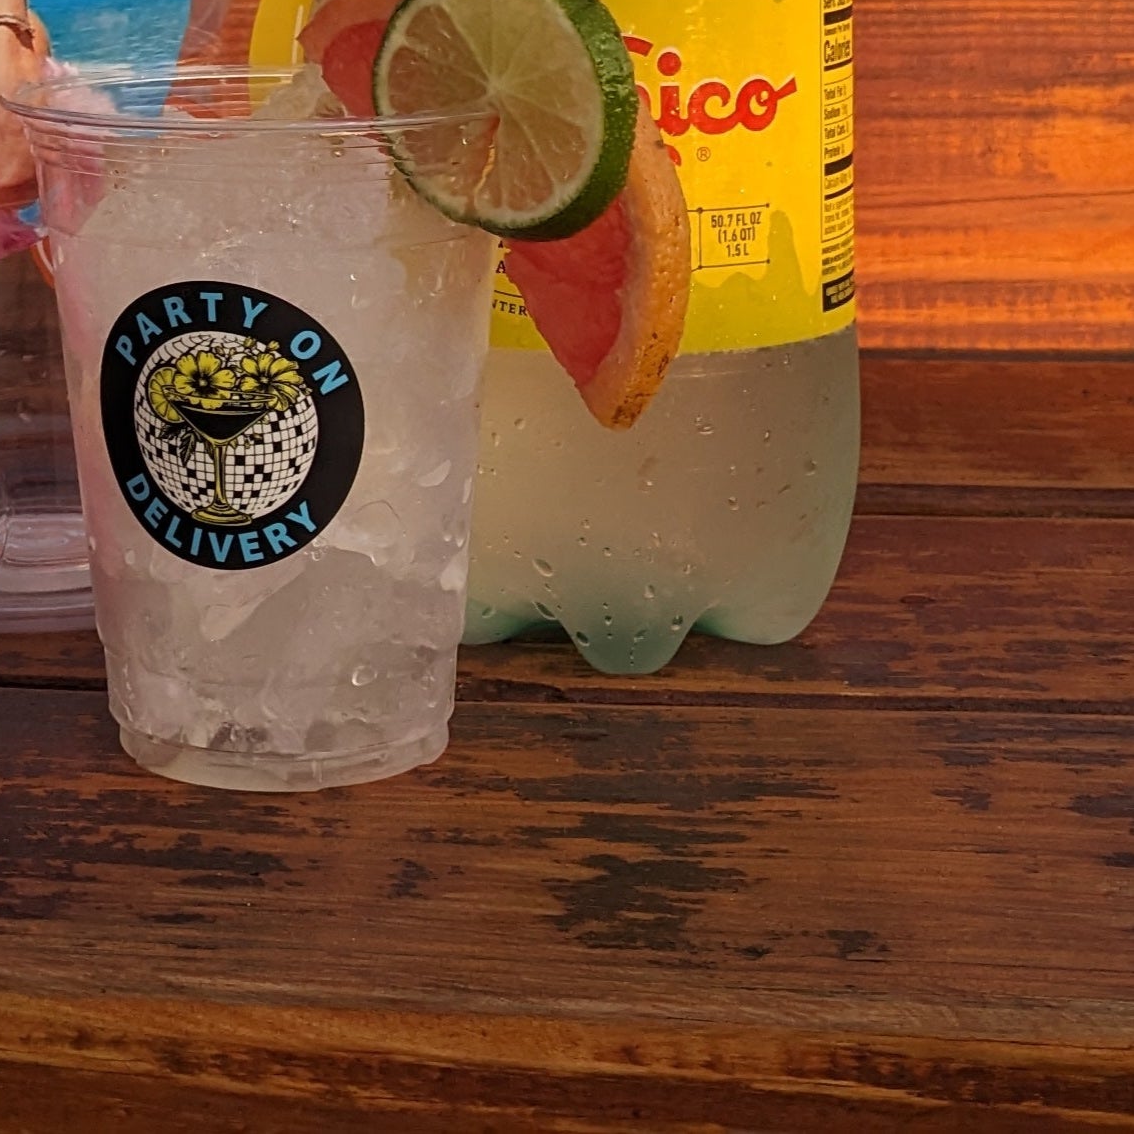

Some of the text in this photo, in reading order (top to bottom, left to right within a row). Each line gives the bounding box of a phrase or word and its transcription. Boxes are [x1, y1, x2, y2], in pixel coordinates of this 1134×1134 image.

[711, 211, 762, 228] 50.7 FL OZ
[718, 229, 737, 244] (1.6
[726, 243, 750, 257] 1.5 L
[115, 292, 350, 396] PARTY ON
[126, 472, 317, 563] DELIVERY
